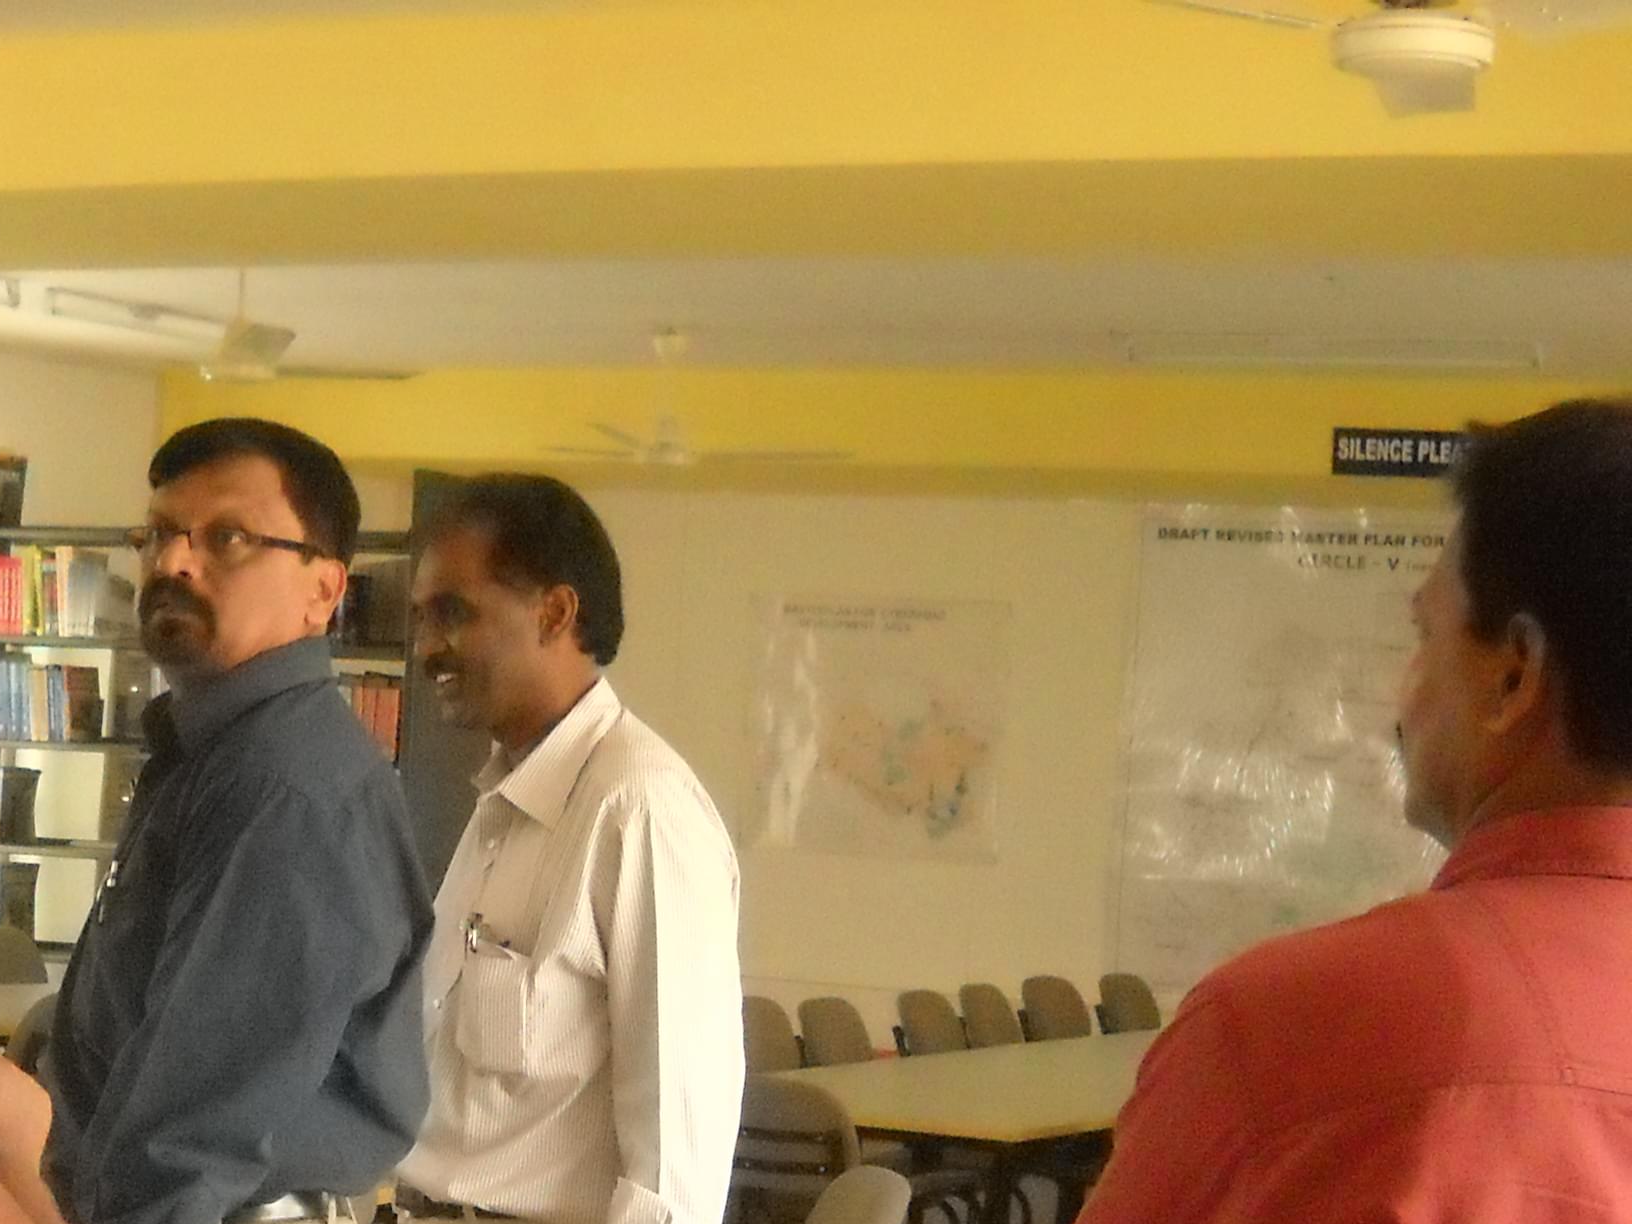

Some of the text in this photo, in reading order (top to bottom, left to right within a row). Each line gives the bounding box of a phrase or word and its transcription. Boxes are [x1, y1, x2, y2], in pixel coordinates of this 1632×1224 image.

[1337, 437, 1469, 464] SILENCE PLEA
[1157, 527, 1209, 541] DRAFT
[1364, 533, 1406, 547] PLAN
[1412, 535, 1446, 548] FOR
